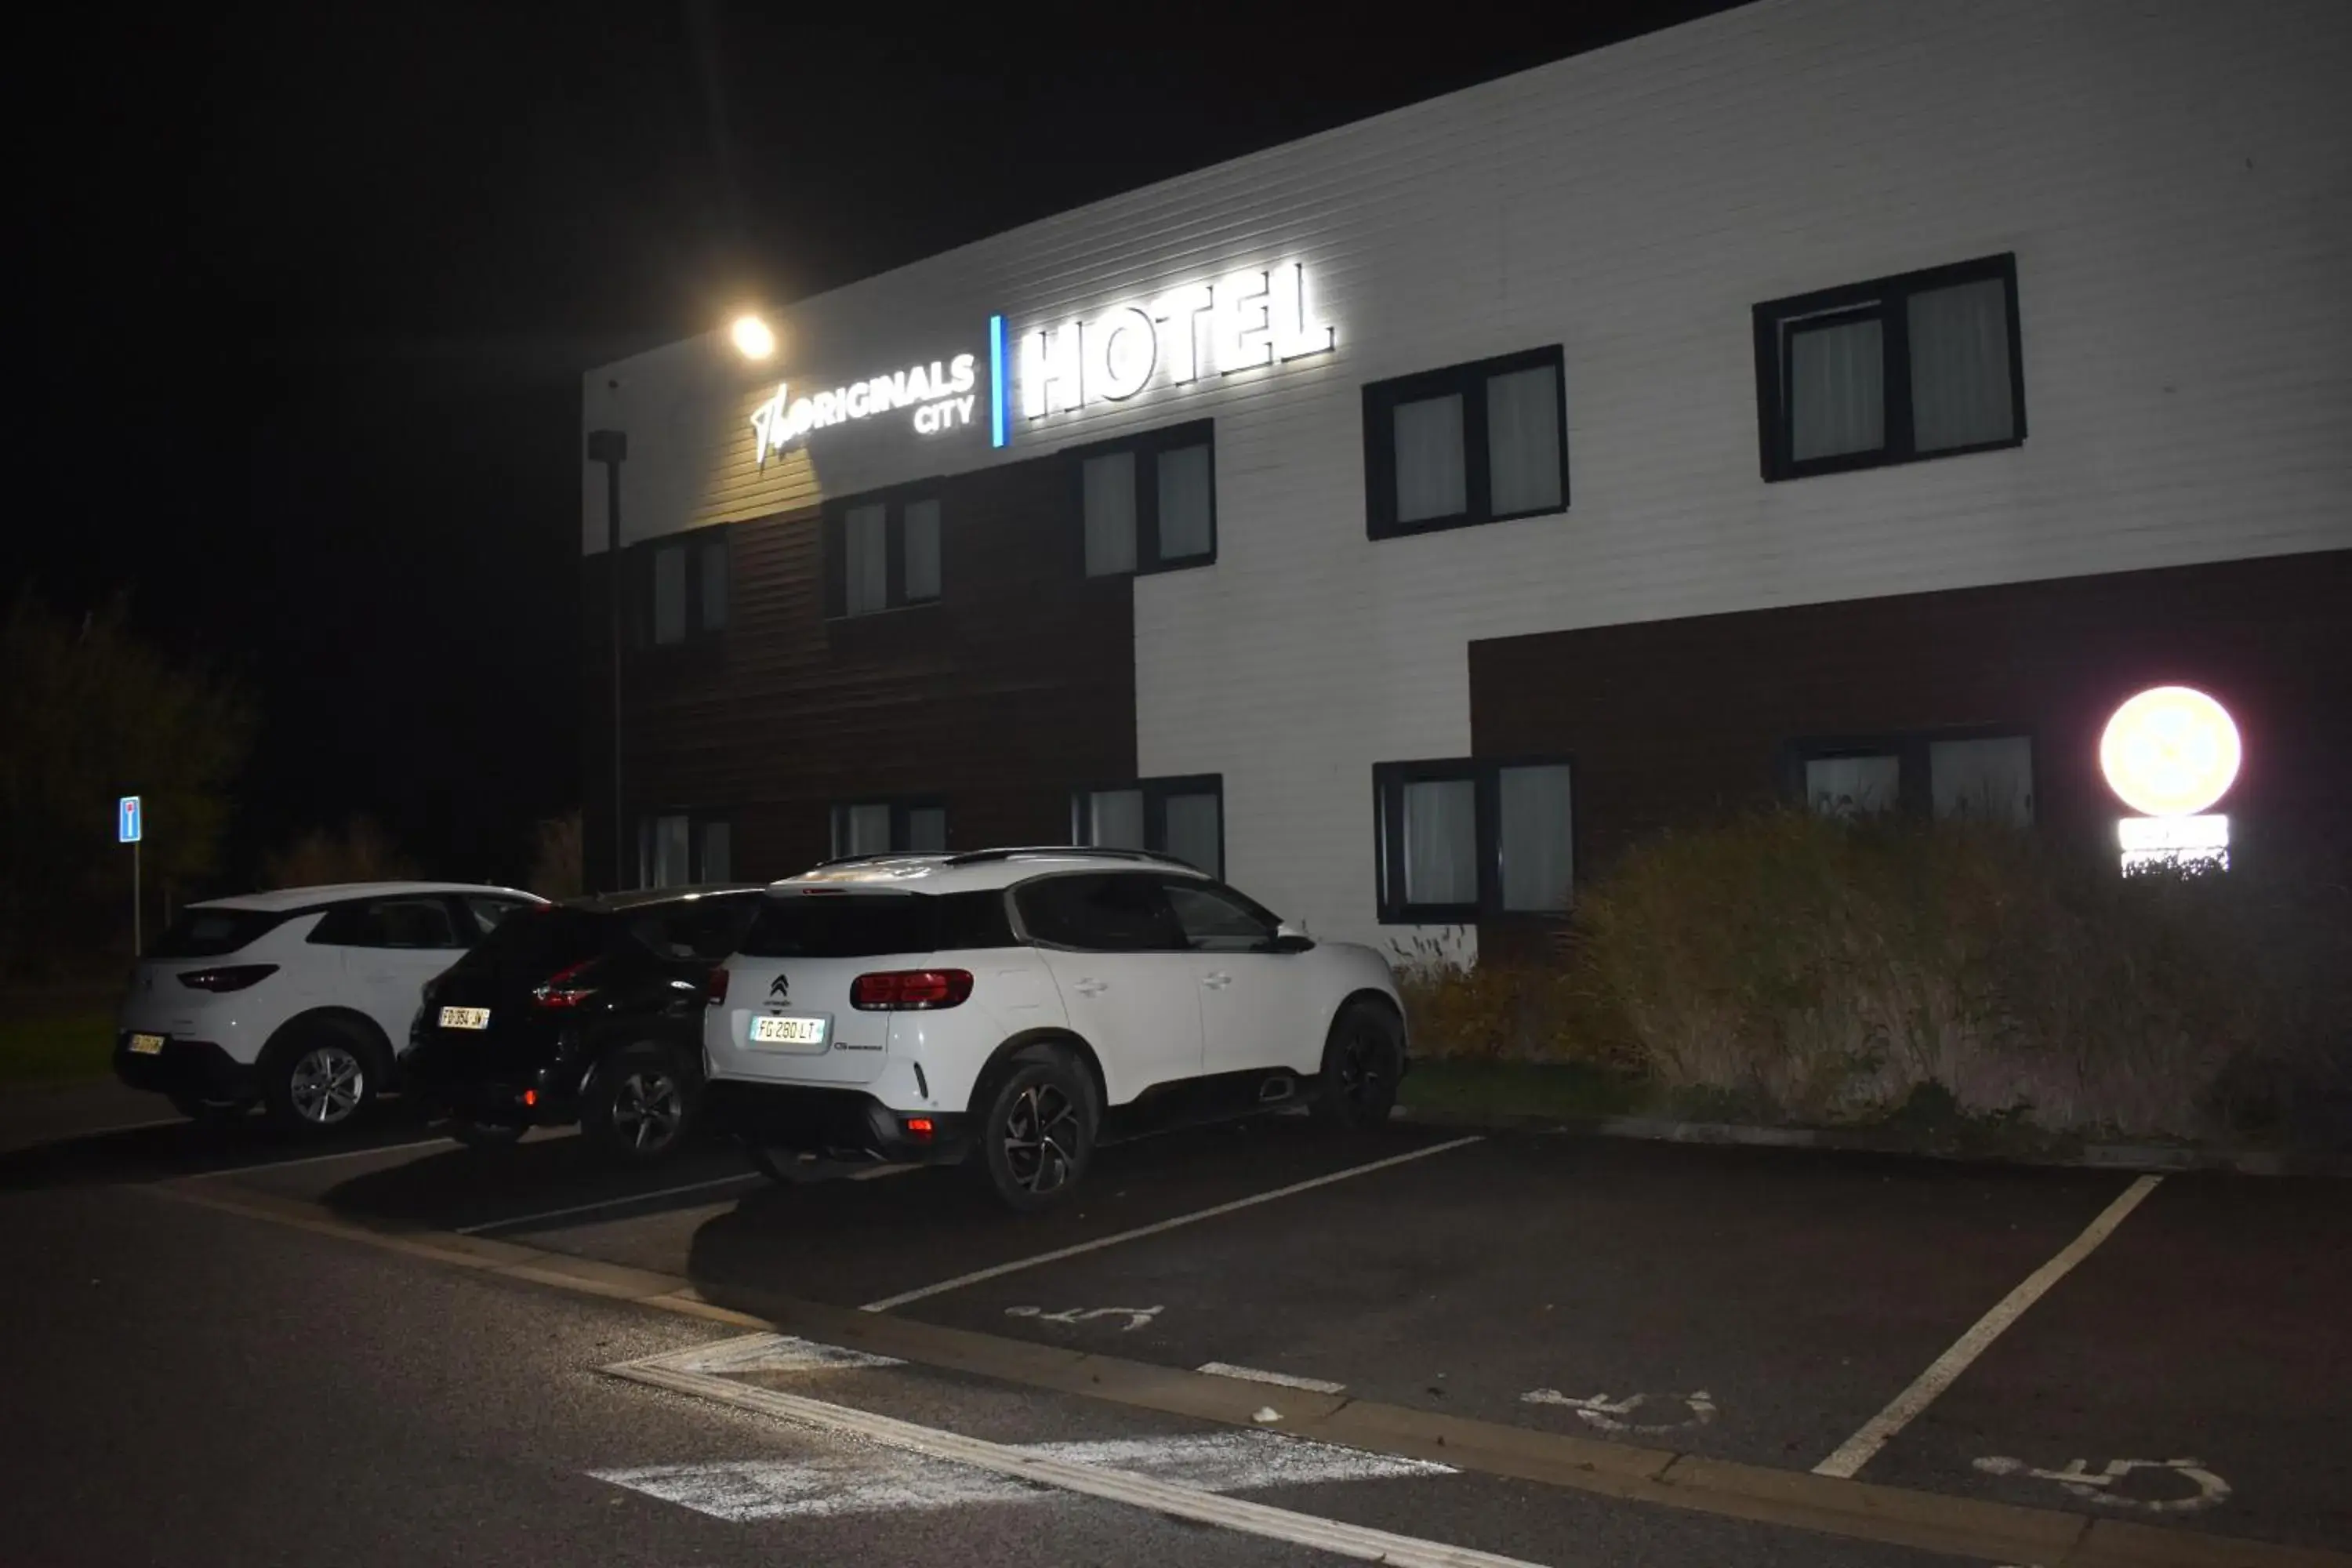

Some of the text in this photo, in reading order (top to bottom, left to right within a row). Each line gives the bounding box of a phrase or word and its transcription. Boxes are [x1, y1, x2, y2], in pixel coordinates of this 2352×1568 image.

[1021, 261, 1336, 421] HOTEL
[788, 354, 975, 432] ORIGINALS
[914, 395, 975, 434] CITY
